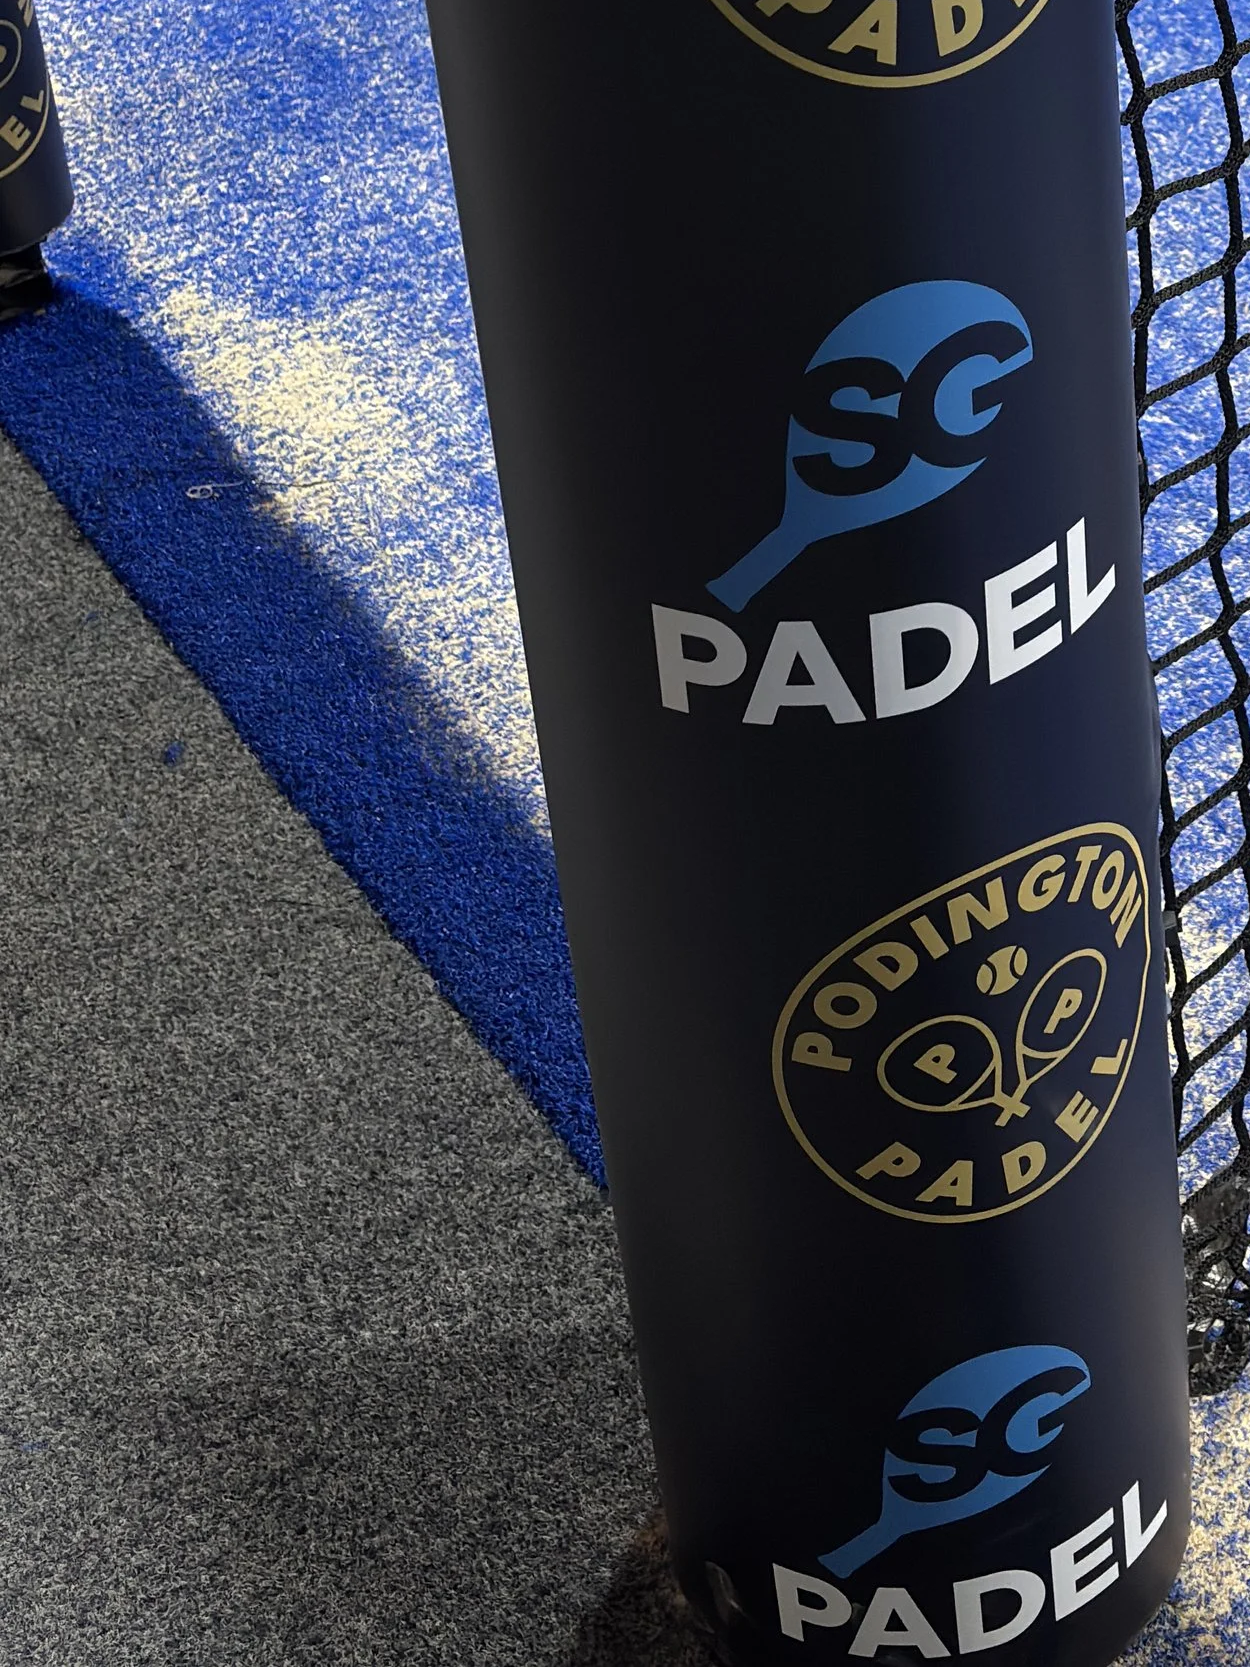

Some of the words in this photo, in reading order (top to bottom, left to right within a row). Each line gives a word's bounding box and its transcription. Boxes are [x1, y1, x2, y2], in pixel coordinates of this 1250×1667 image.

[793, 321, 1029, 496] SG
[651, 517, 1116, 725] PADEL
[791, 845, 1142, 1072] PODINGTON
[914, 1043, 957, 1084] P
[1044, 988, 1082, 1034] P
[856, 1038, 1128, 1206] PADEL
[886, 1366, 1087, 1502] SG
[772, 1480, 1168, 1658] PADEL
